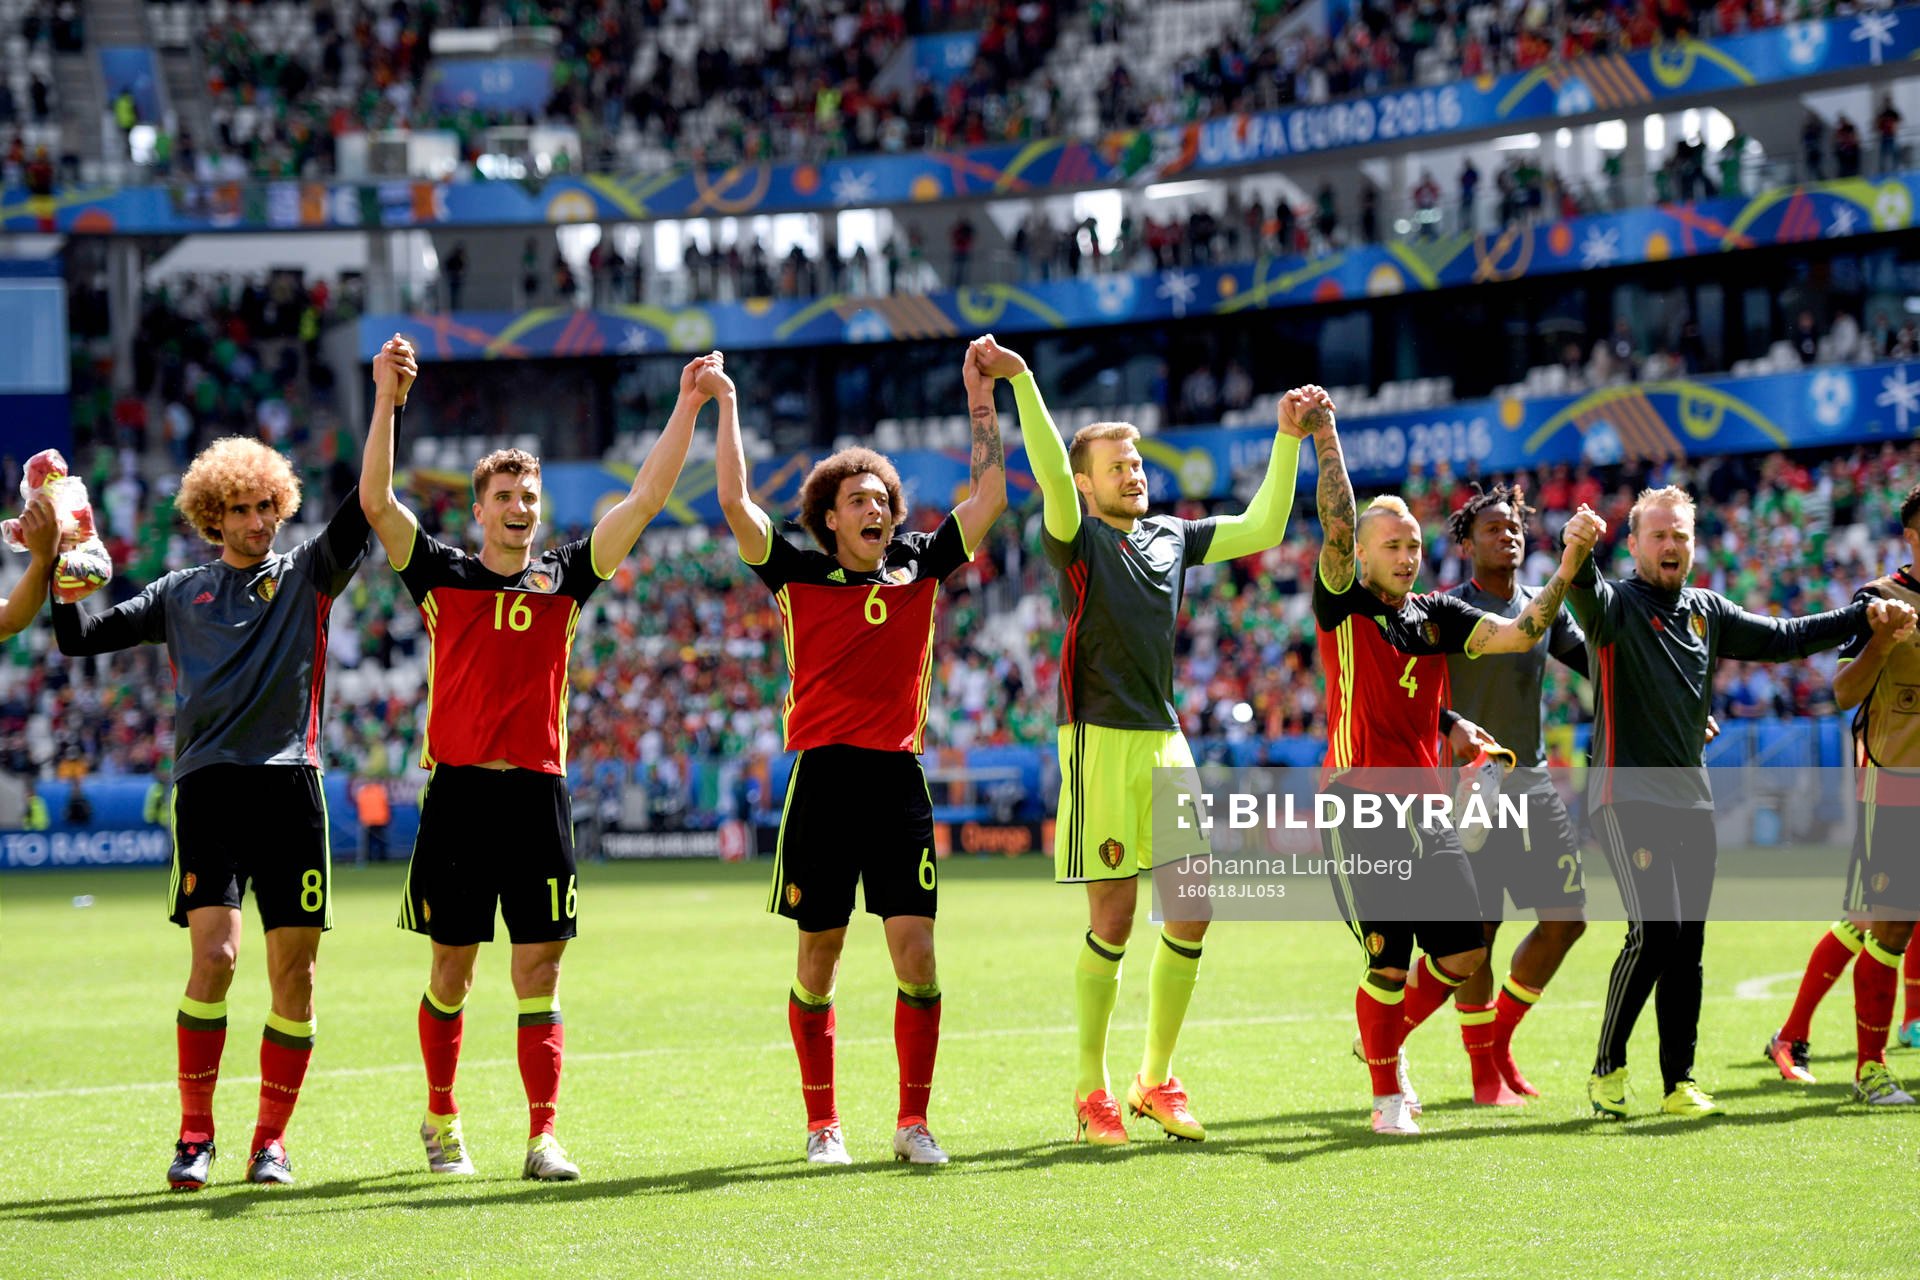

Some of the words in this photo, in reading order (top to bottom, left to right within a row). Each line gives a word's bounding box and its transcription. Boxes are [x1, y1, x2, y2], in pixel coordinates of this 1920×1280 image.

[1200, 112, 1288, 163] UEFA
[1289, 100, 1376, 151] EURO
[1378, 86, 1462, 138] 2016
[1409, 418, 1492, 466] 2016
[494, 592, 532, 632] 16
[864, 584, 887, 625] 6
[1399, 656, 1418, 698] 4
[5, 833, 49, 866] TO
[51, 829, 168, 864] RACISM
[919, 848, 935, 890] 6
[301, 869, 323, 912] 8
[547, 874, 577, 921] 16
